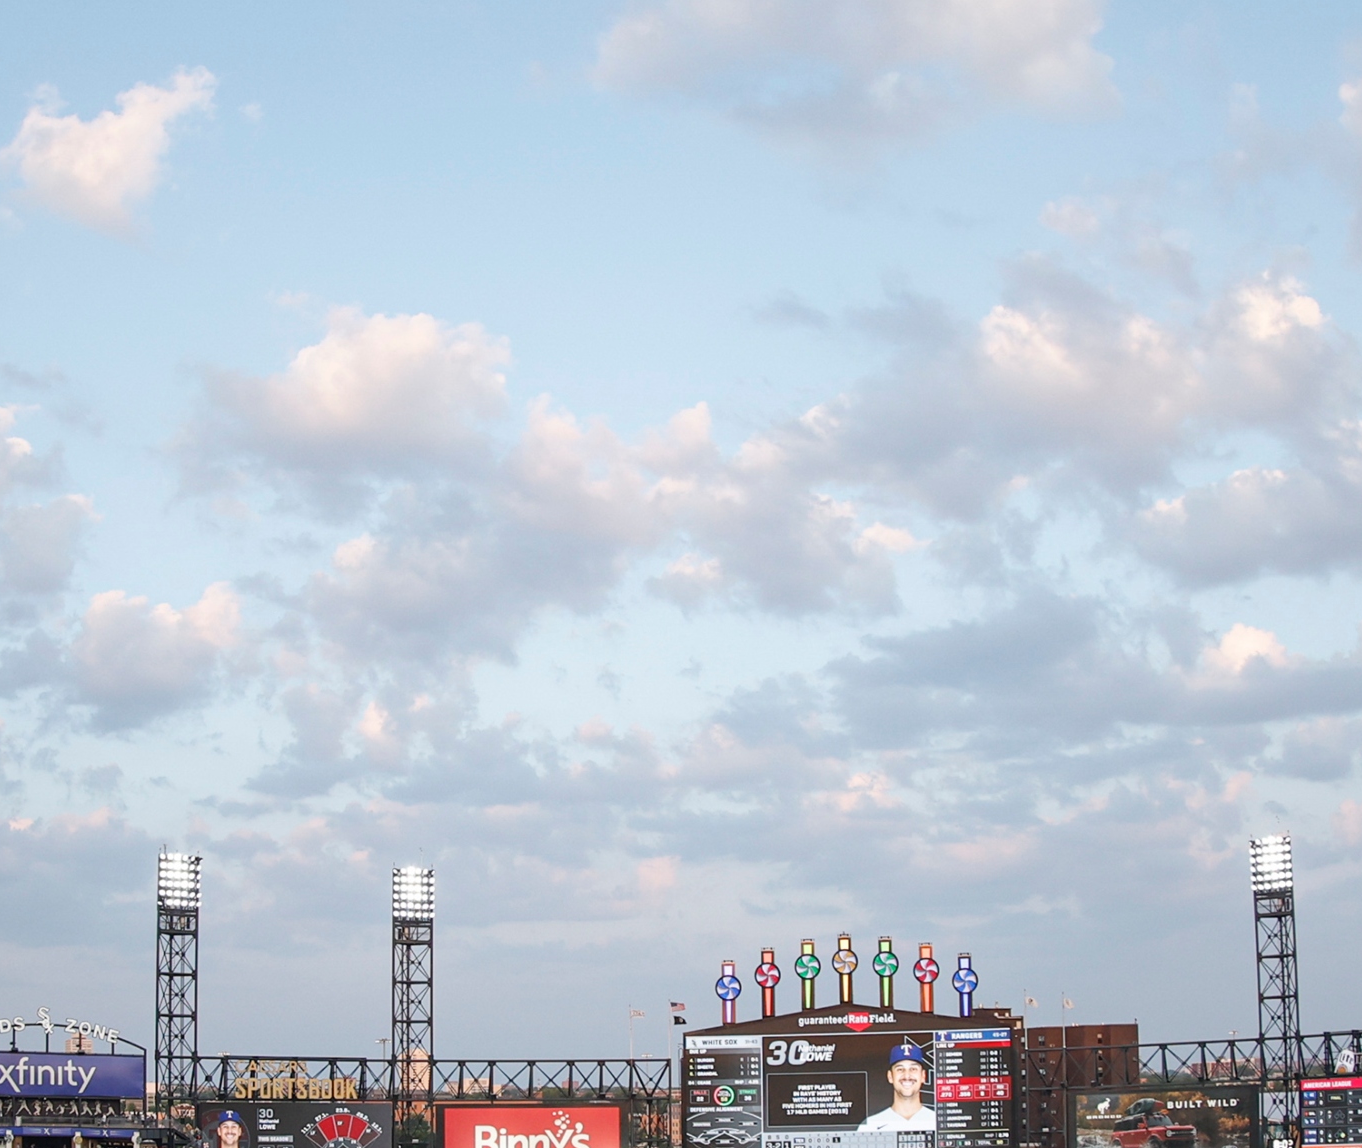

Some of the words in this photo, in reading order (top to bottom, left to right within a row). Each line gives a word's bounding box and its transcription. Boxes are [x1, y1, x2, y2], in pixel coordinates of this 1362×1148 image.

[798, 1015, 848, 1027] guaranteed
[848, 1013, 868, 1024] Rate
[65, 1018, 120, 1044] ZONE
[799, 1051, 834, 1062] LOWE
[236, 1060, 308, 1074] CAESARS
[235, 1077, 359, 1100] SPORTSBOOK
[1303, 1081, 1331, 1089] AMERICAN
[1331, 1080, 1352, 1088] LEAGUE
[1166, 1100, 1203, 1110] BUILT
[1207, 1098, 1237, 1108] WILD
[259, 1108, 274, 1119] 30
[258, 1123, 277, 1131] LOWE
